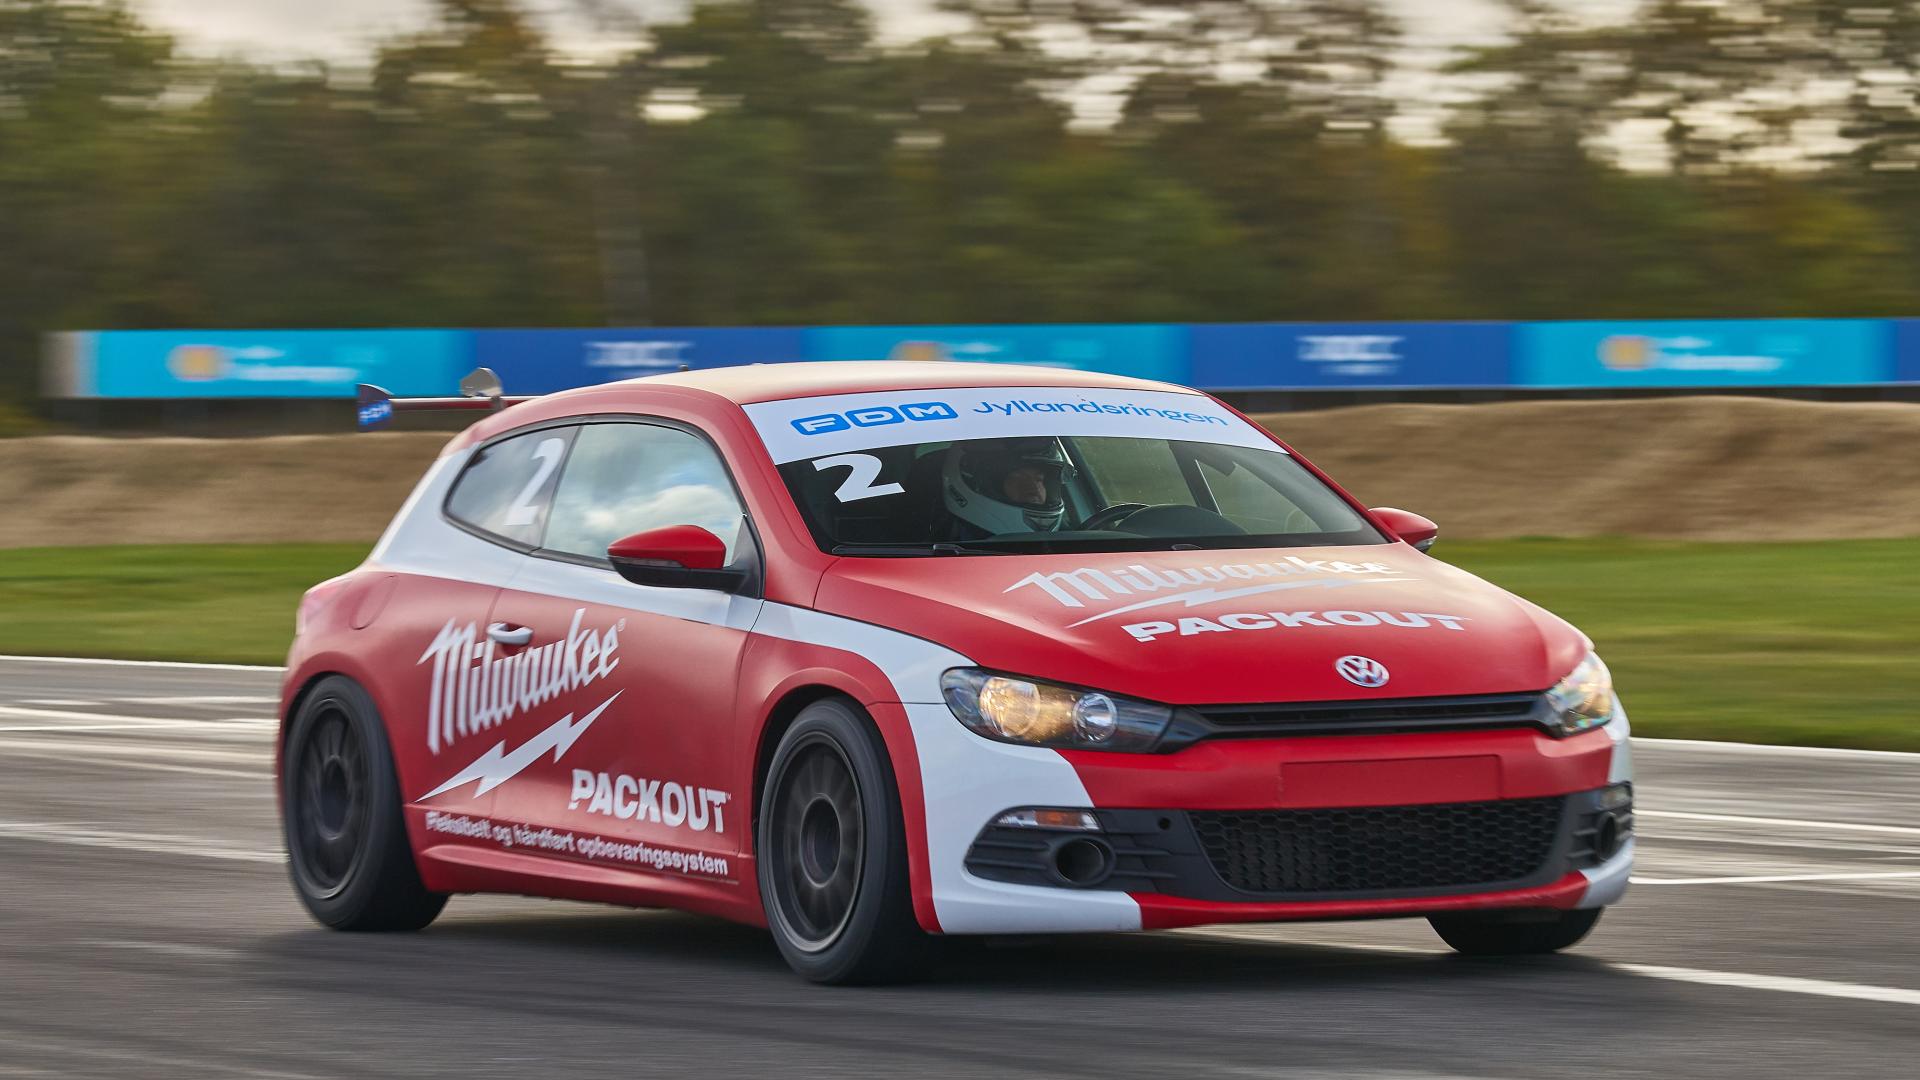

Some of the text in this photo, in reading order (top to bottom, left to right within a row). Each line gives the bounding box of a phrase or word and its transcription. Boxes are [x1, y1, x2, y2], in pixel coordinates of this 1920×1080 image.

[792, 400, 1229, 435] FDM Jyllandsringen
[504, 438, 566, 526] 2
[812, 453, 906, 503] 2
[1002, 556, 1402, 608] Milwaukee
[1121, 610, 1465, 642] PACKOUT
[568, 768, 730, 833] PACKOUT
[577, 836, 728, 875] opbevaringssystem
